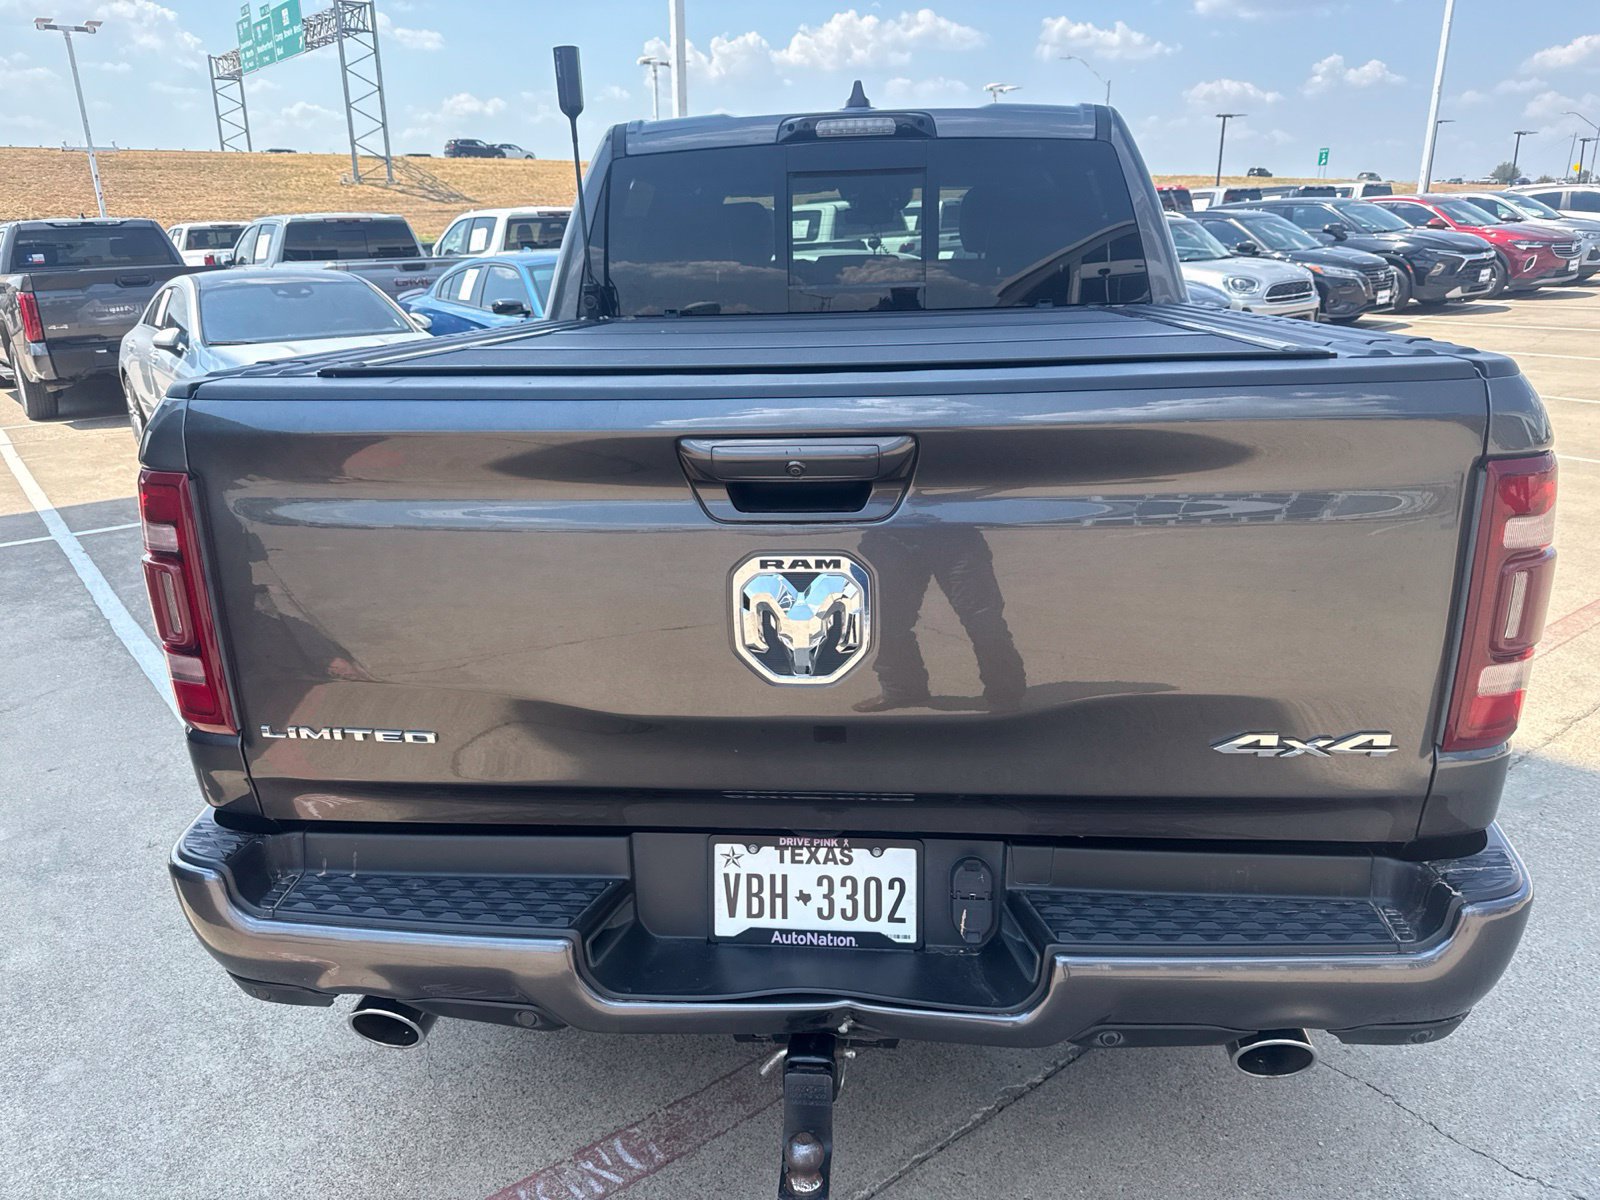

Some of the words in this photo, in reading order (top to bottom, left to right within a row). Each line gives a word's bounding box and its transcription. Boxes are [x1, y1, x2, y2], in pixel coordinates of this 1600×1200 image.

[759, 559, 841, 569] RAM
[260, 724, 439, 744] LIMITED
[1211, 730, 1399, 757] 4x4
[779, 837, 811, 847] DRIVE
[813, 838, 838, 847] PINK
[774, 846, 854, 866] TEXAS
[723, 872, 788, 919] VBH
[816, 874, 907, 924] 3302
